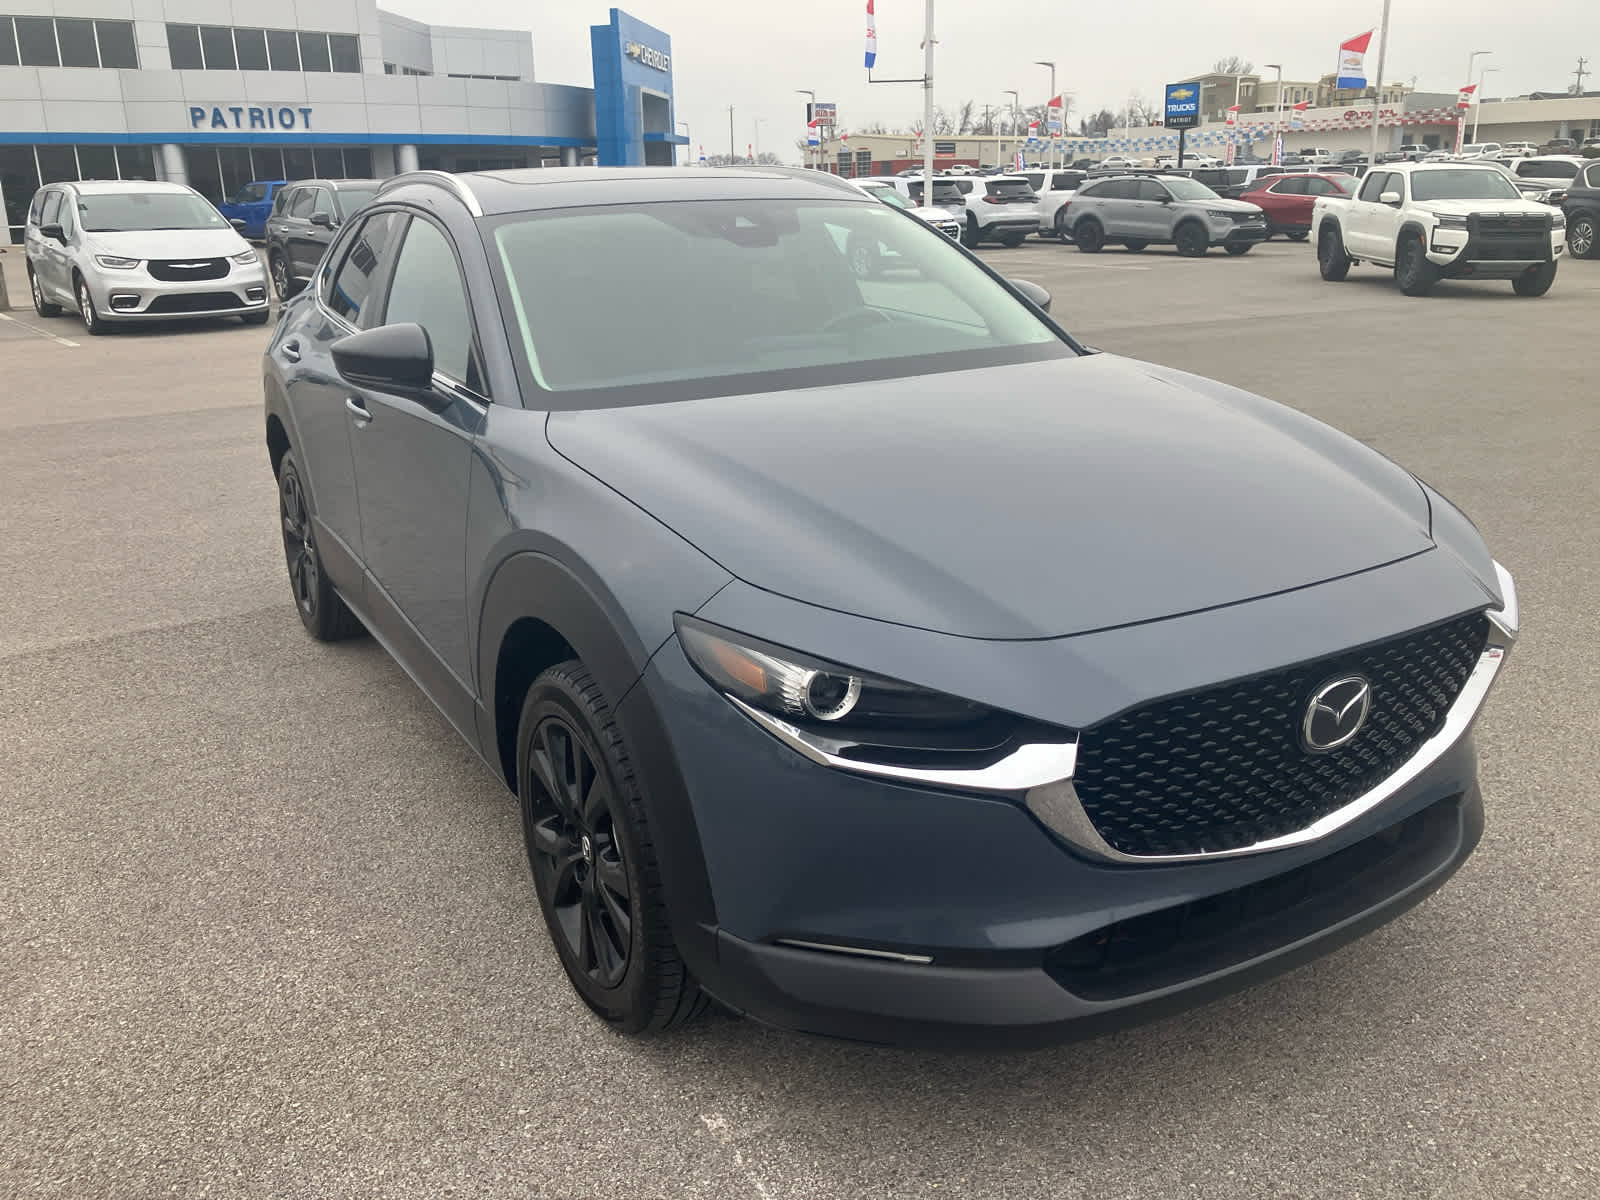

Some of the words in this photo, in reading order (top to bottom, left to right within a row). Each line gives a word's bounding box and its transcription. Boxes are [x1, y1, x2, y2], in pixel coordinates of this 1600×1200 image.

[640, 44, 670, 71] CHEVROLET
[190, 107, 312, 129] PATRIOT
[1167, 103, 1196, 112] TRUCKS
